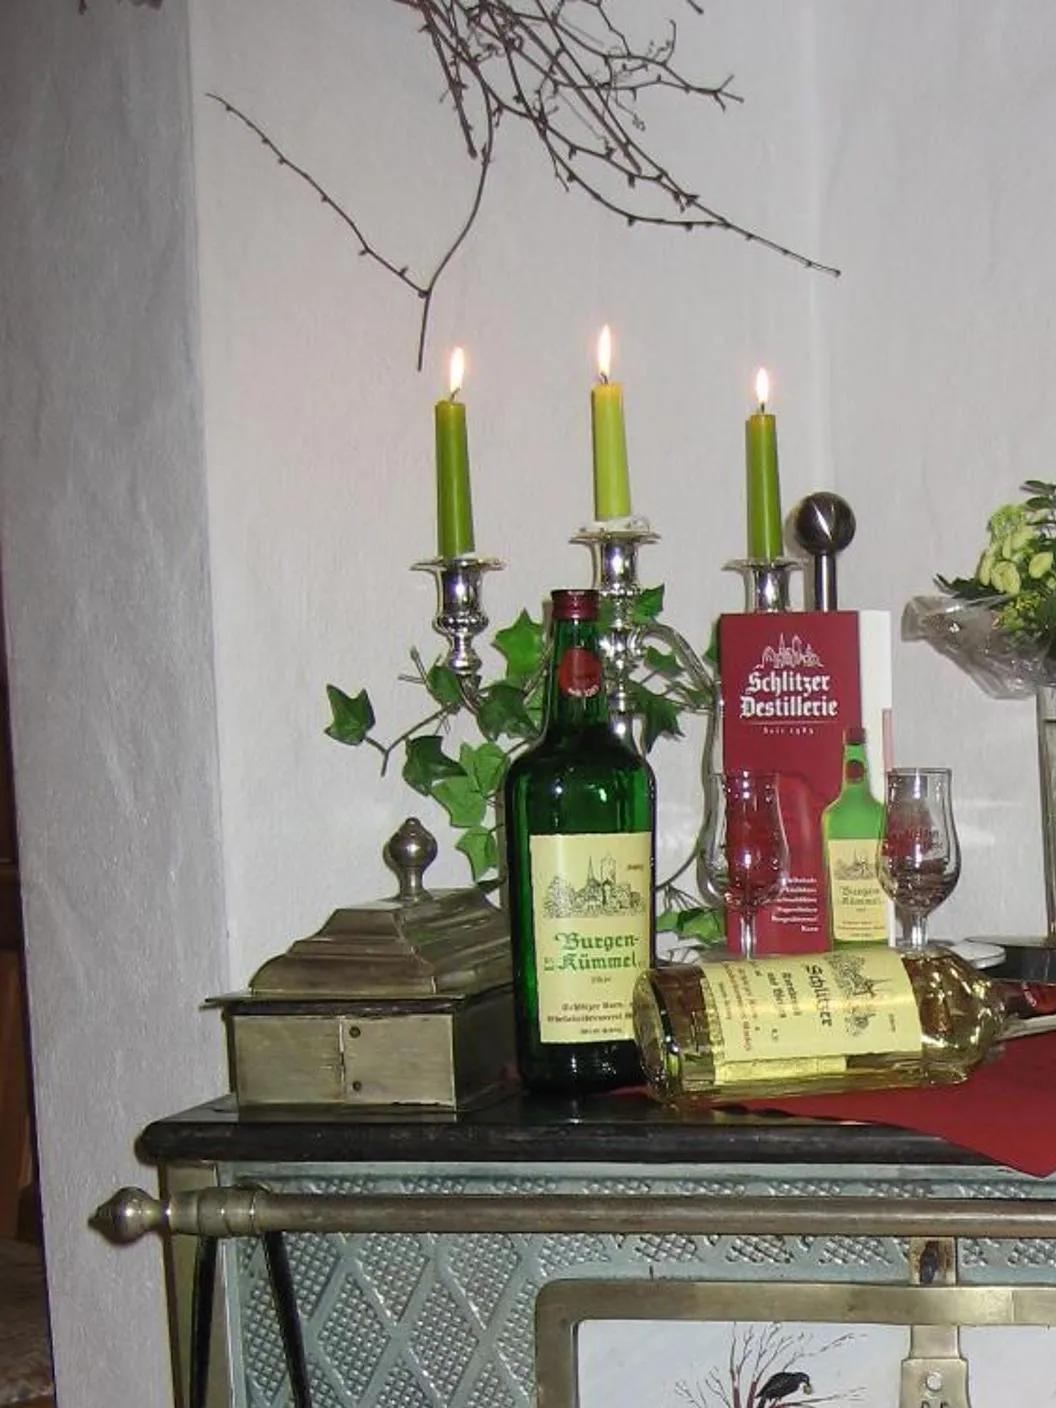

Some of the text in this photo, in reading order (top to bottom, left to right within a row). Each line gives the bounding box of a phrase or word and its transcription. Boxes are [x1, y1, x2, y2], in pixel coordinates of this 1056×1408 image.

[745, 671, 830, 697] Schlitzer
[740, 696, 838, 719] Destillerie
[554, 931, 639, 952] Burgen-
[558, 951, 638, 971] Kümmel
